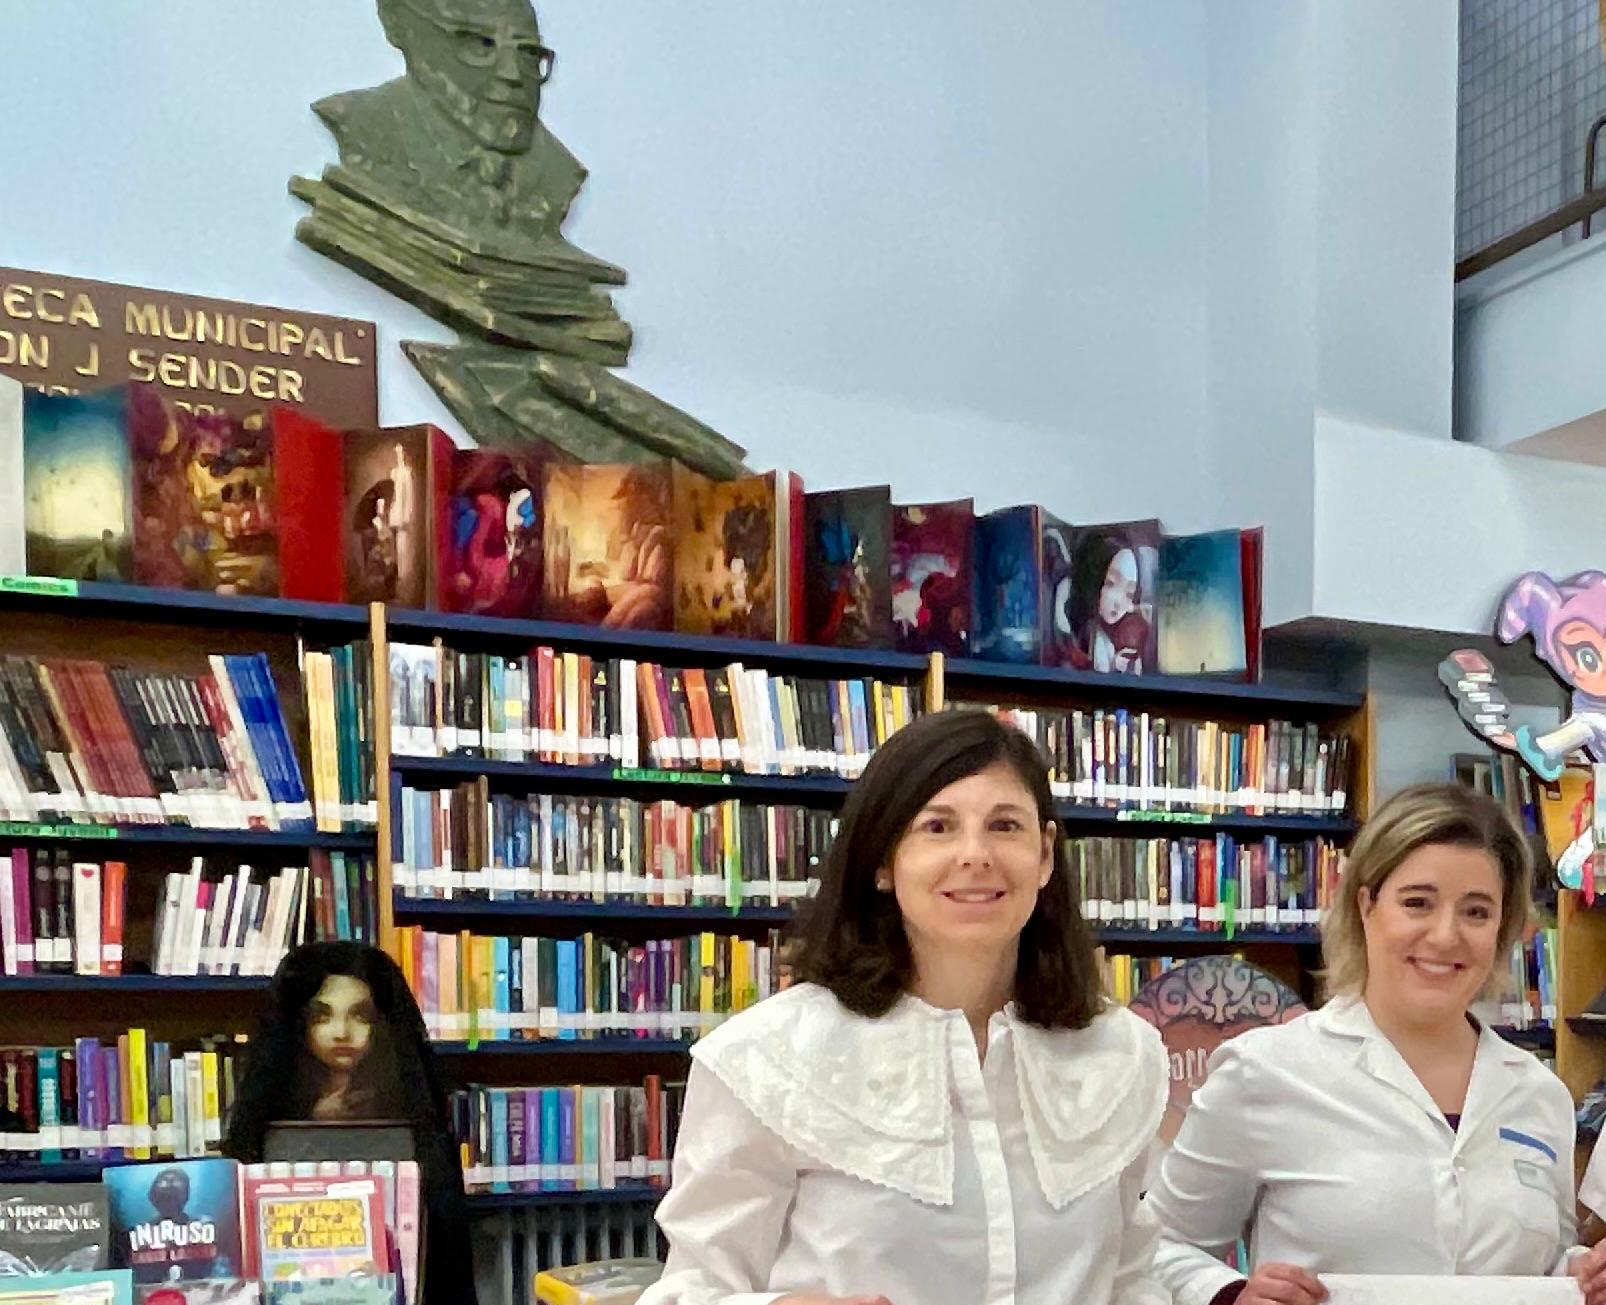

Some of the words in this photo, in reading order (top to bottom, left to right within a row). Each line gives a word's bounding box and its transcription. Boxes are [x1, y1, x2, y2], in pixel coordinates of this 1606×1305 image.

[125, 301, 360, 366] MUNICIPAL
[73, 343, 99, 376] J
[128, 348, 304, 402] SENDER
[129, 1220, 215, 1251] INTRUSO
